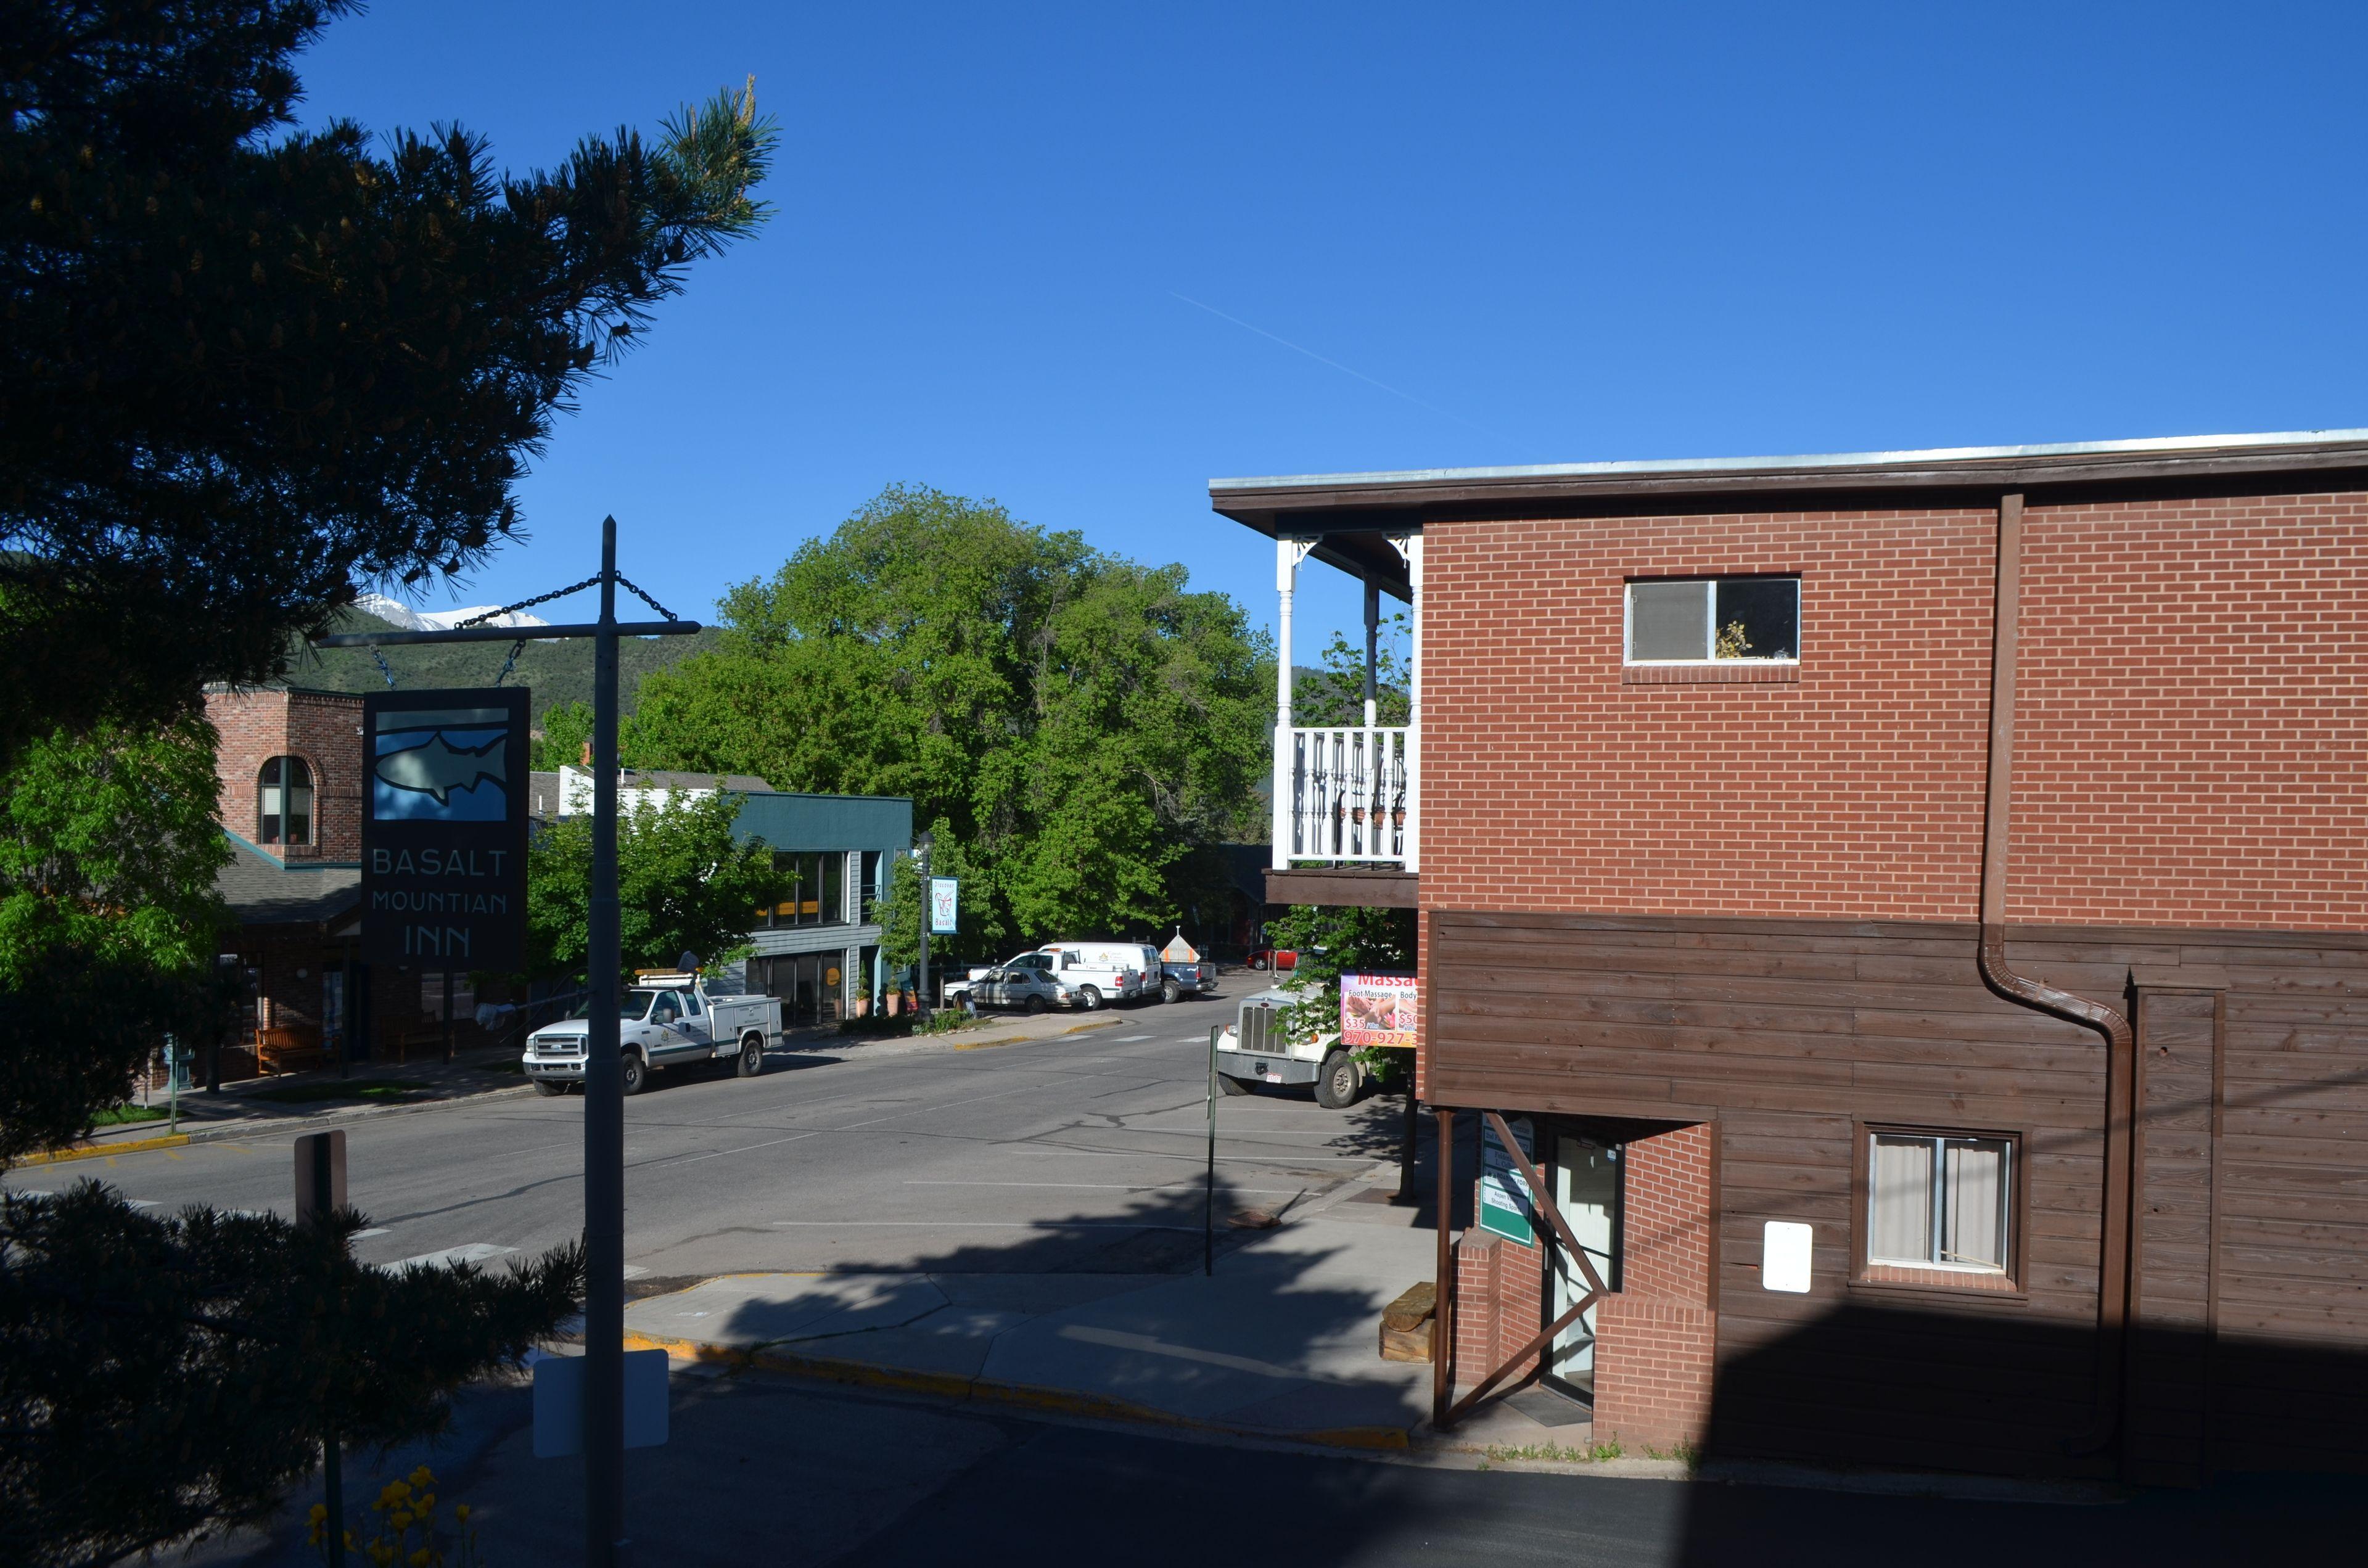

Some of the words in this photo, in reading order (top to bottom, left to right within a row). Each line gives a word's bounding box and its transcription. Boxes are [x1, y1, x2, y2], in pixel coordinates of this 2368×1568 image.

[373, 848, 507, 876] BASALT
[372, 890, 506, 914] MOUNTIAN
[405, 926, 469, 957] INN
[1359, 972, 1418, 989] Massa
[1365, 990, 1392, 999] Massage
[1400, 991, 1416, 1000] Body
[1346, 1018, 1365, 1028] $35
[1495, 1191, 1507, 1200] Aspen
[1491, 1197, 1508, 1209] Shooting
